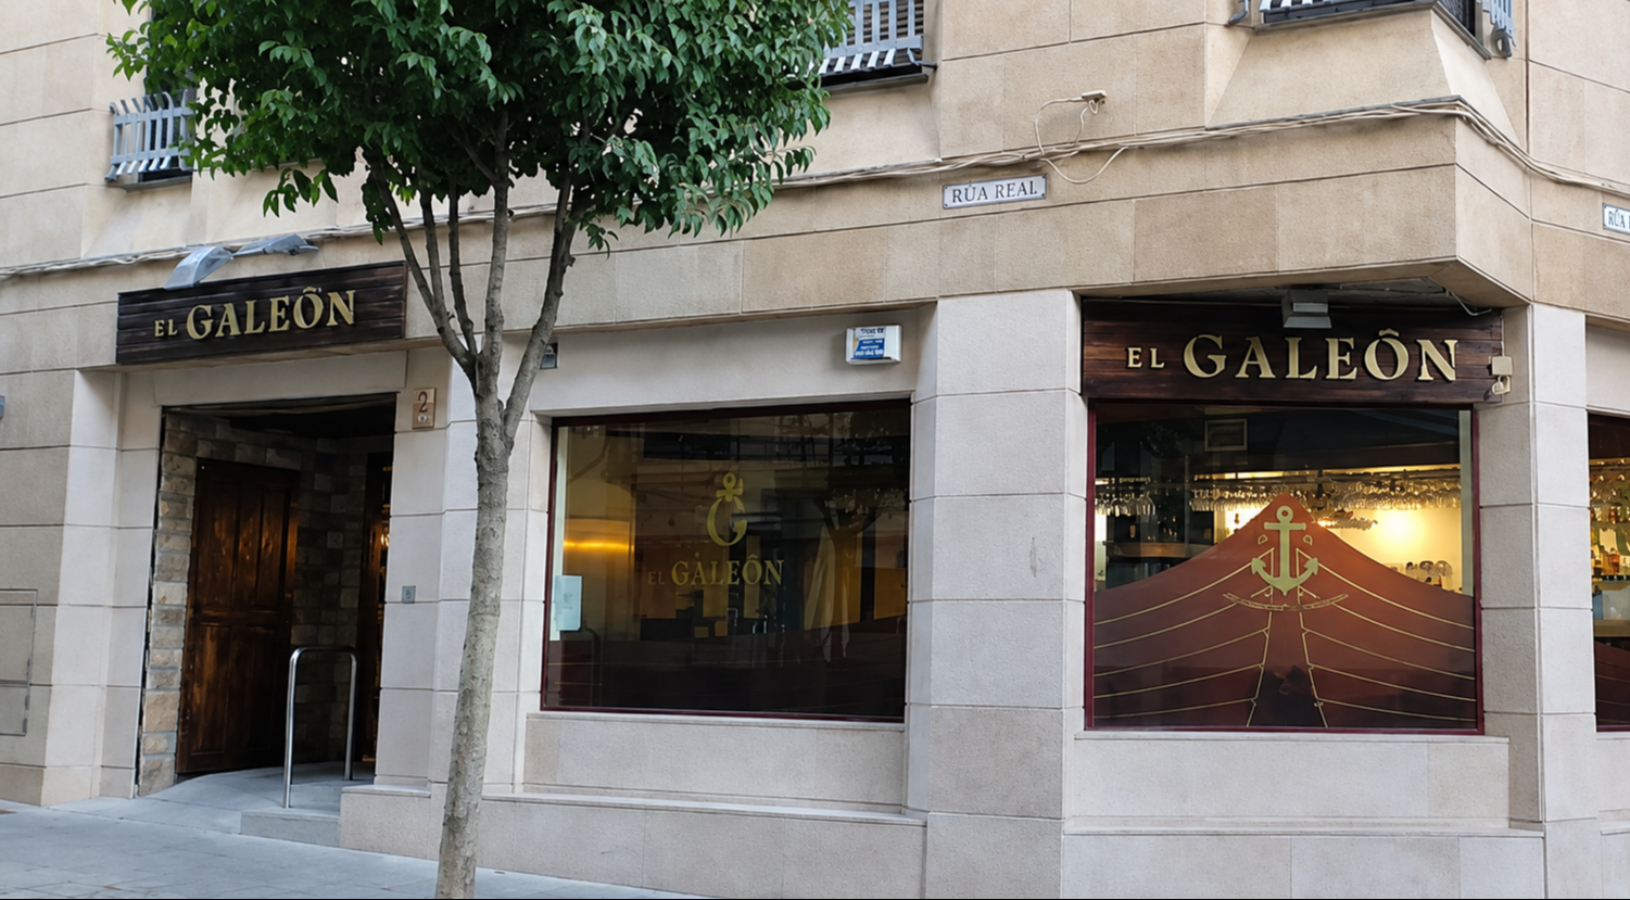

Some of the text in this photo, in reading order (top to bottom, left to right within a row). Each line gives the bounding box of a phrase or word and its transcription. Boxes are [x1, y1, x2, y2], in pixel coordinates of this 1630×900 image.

[952, 181, 1037, 203] RÚA REAL
[154, 319, 178, 337] EL
[1127, 347, 1165, 368] EL
[417, 391, 428, 413] 2
[648, 571, 665, 585] EL
